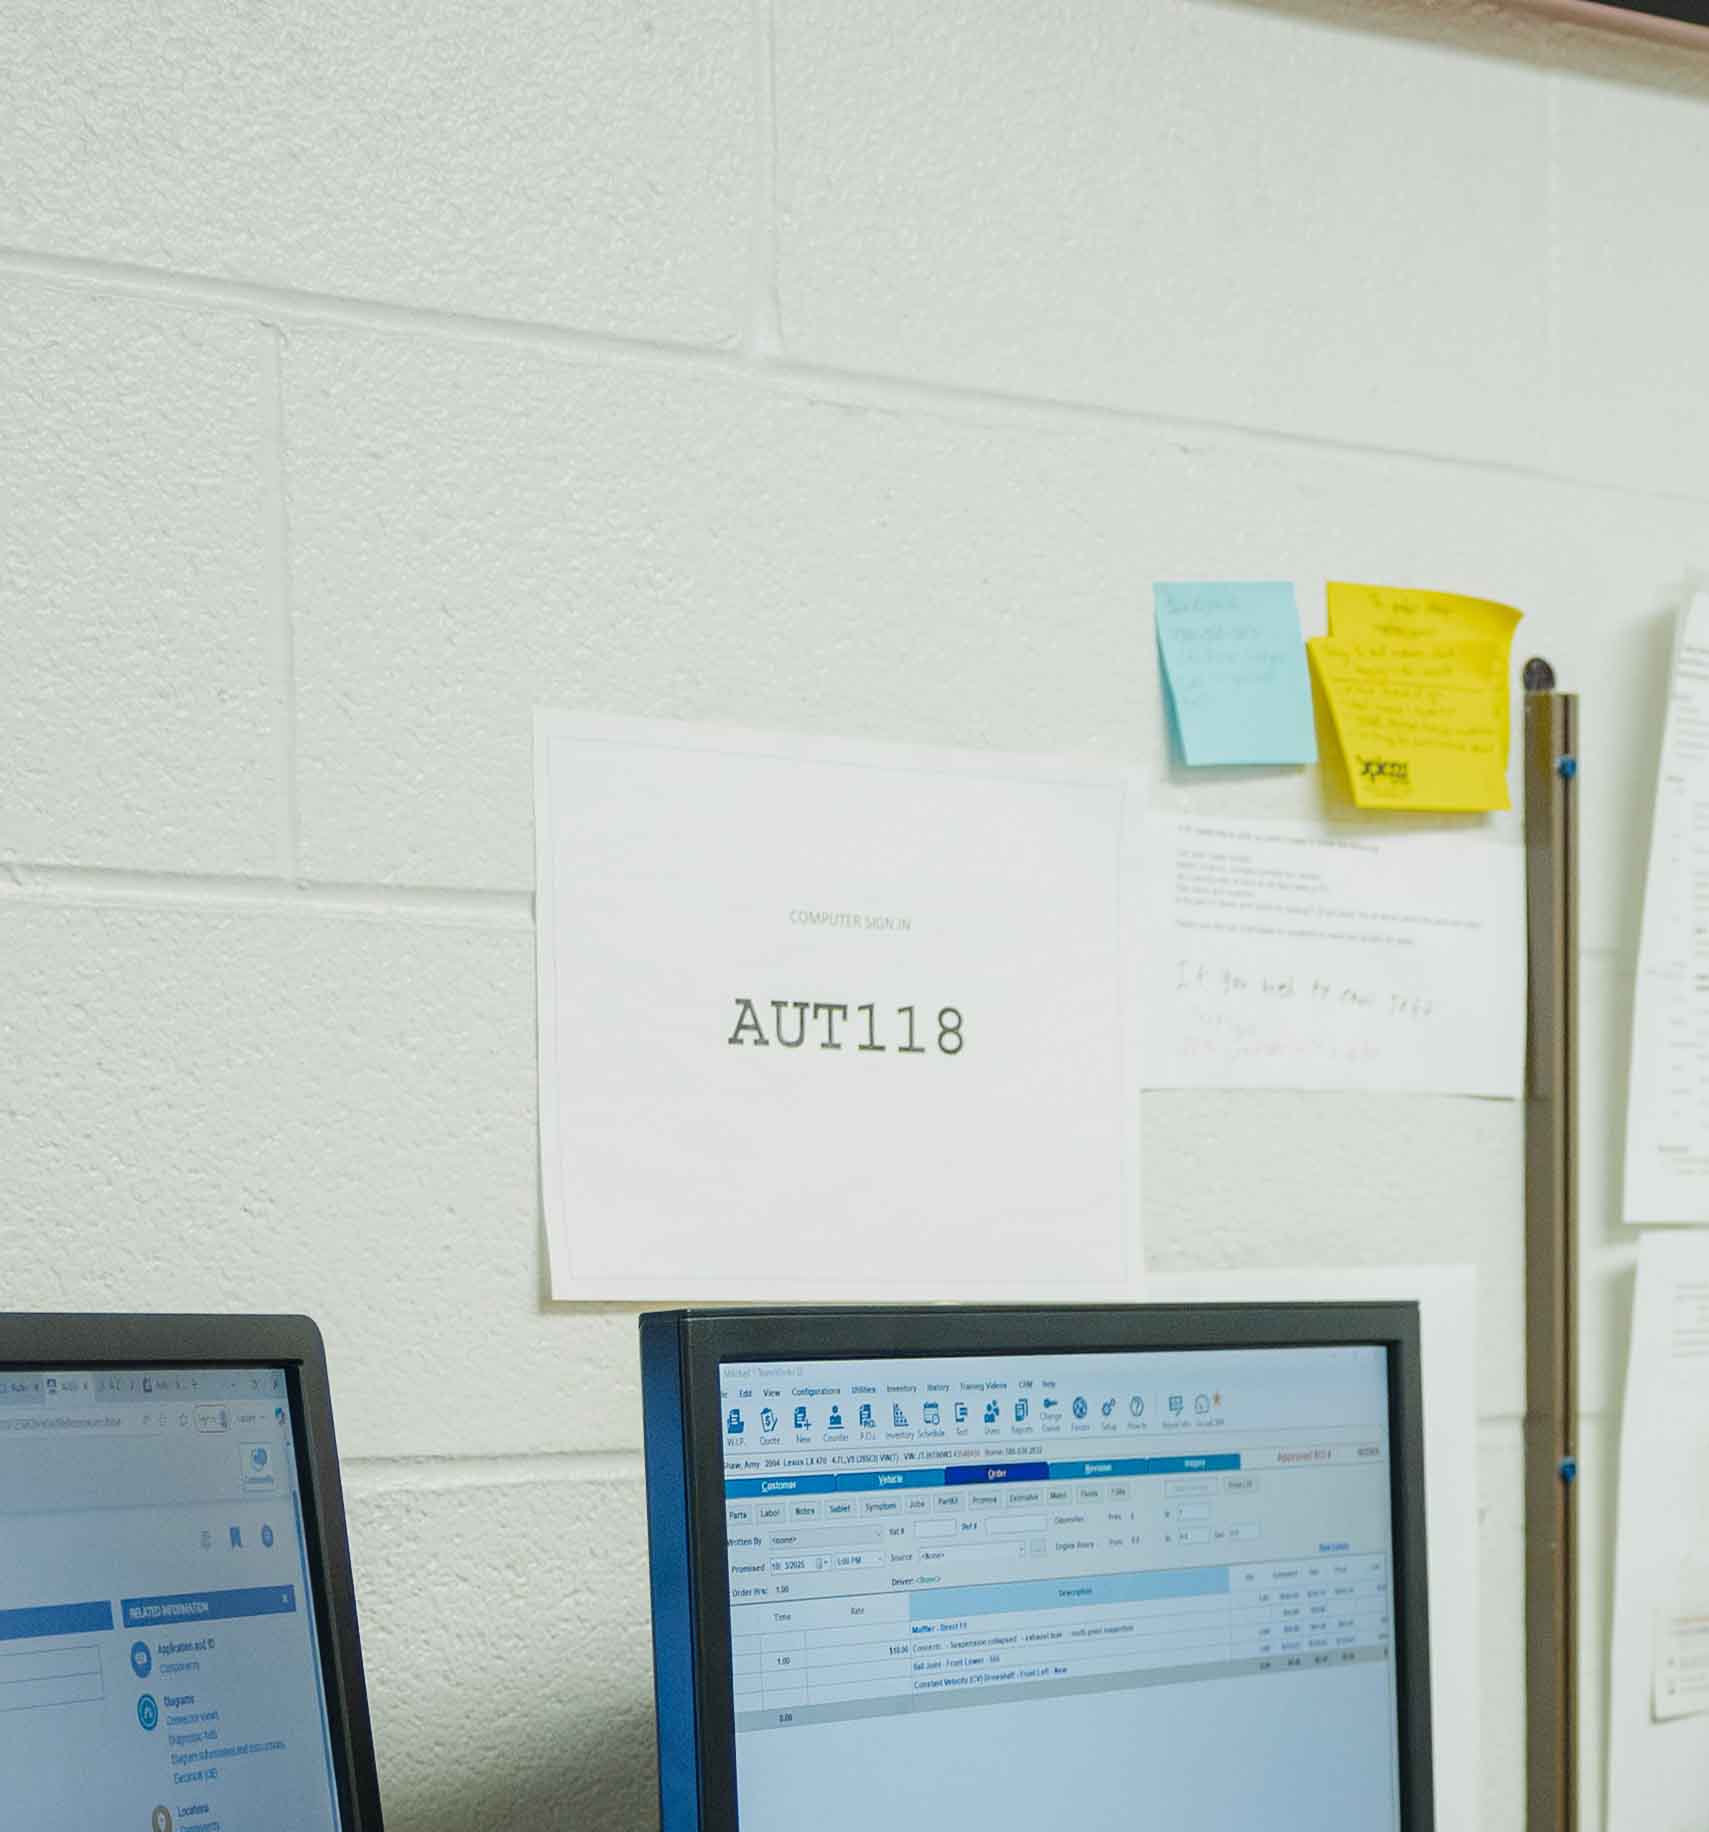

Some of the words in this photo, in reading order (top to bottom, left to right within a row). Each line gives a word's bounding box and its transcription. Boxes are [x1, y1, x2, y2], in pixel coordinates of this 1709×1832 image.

[788, 908, 862, 930] COMPUTER
[864, 915, 895, 934] SIGN
[896, 918, 913, 934] IN
[728, 997, 965, 1056] AUT118
[763, 1388, 781, 1398] View
[791, 1385, 841, 1399] Configurations
[886, 1382, 917, 1394] Inventory
[761, 1480, 796, 1493] Customer
[878, 1475, 904, 1487] Vehicle
[987, 1468, 1008, 1480] Order
[760, 1508, 780, 1519] Labor
[732, 1588, 753, 1599] Order
[128, 1604, 160, 1620] RELATED
[776, 1656, 792, 1666] 1.00
[177, 1803, 209, 1818] Locations
